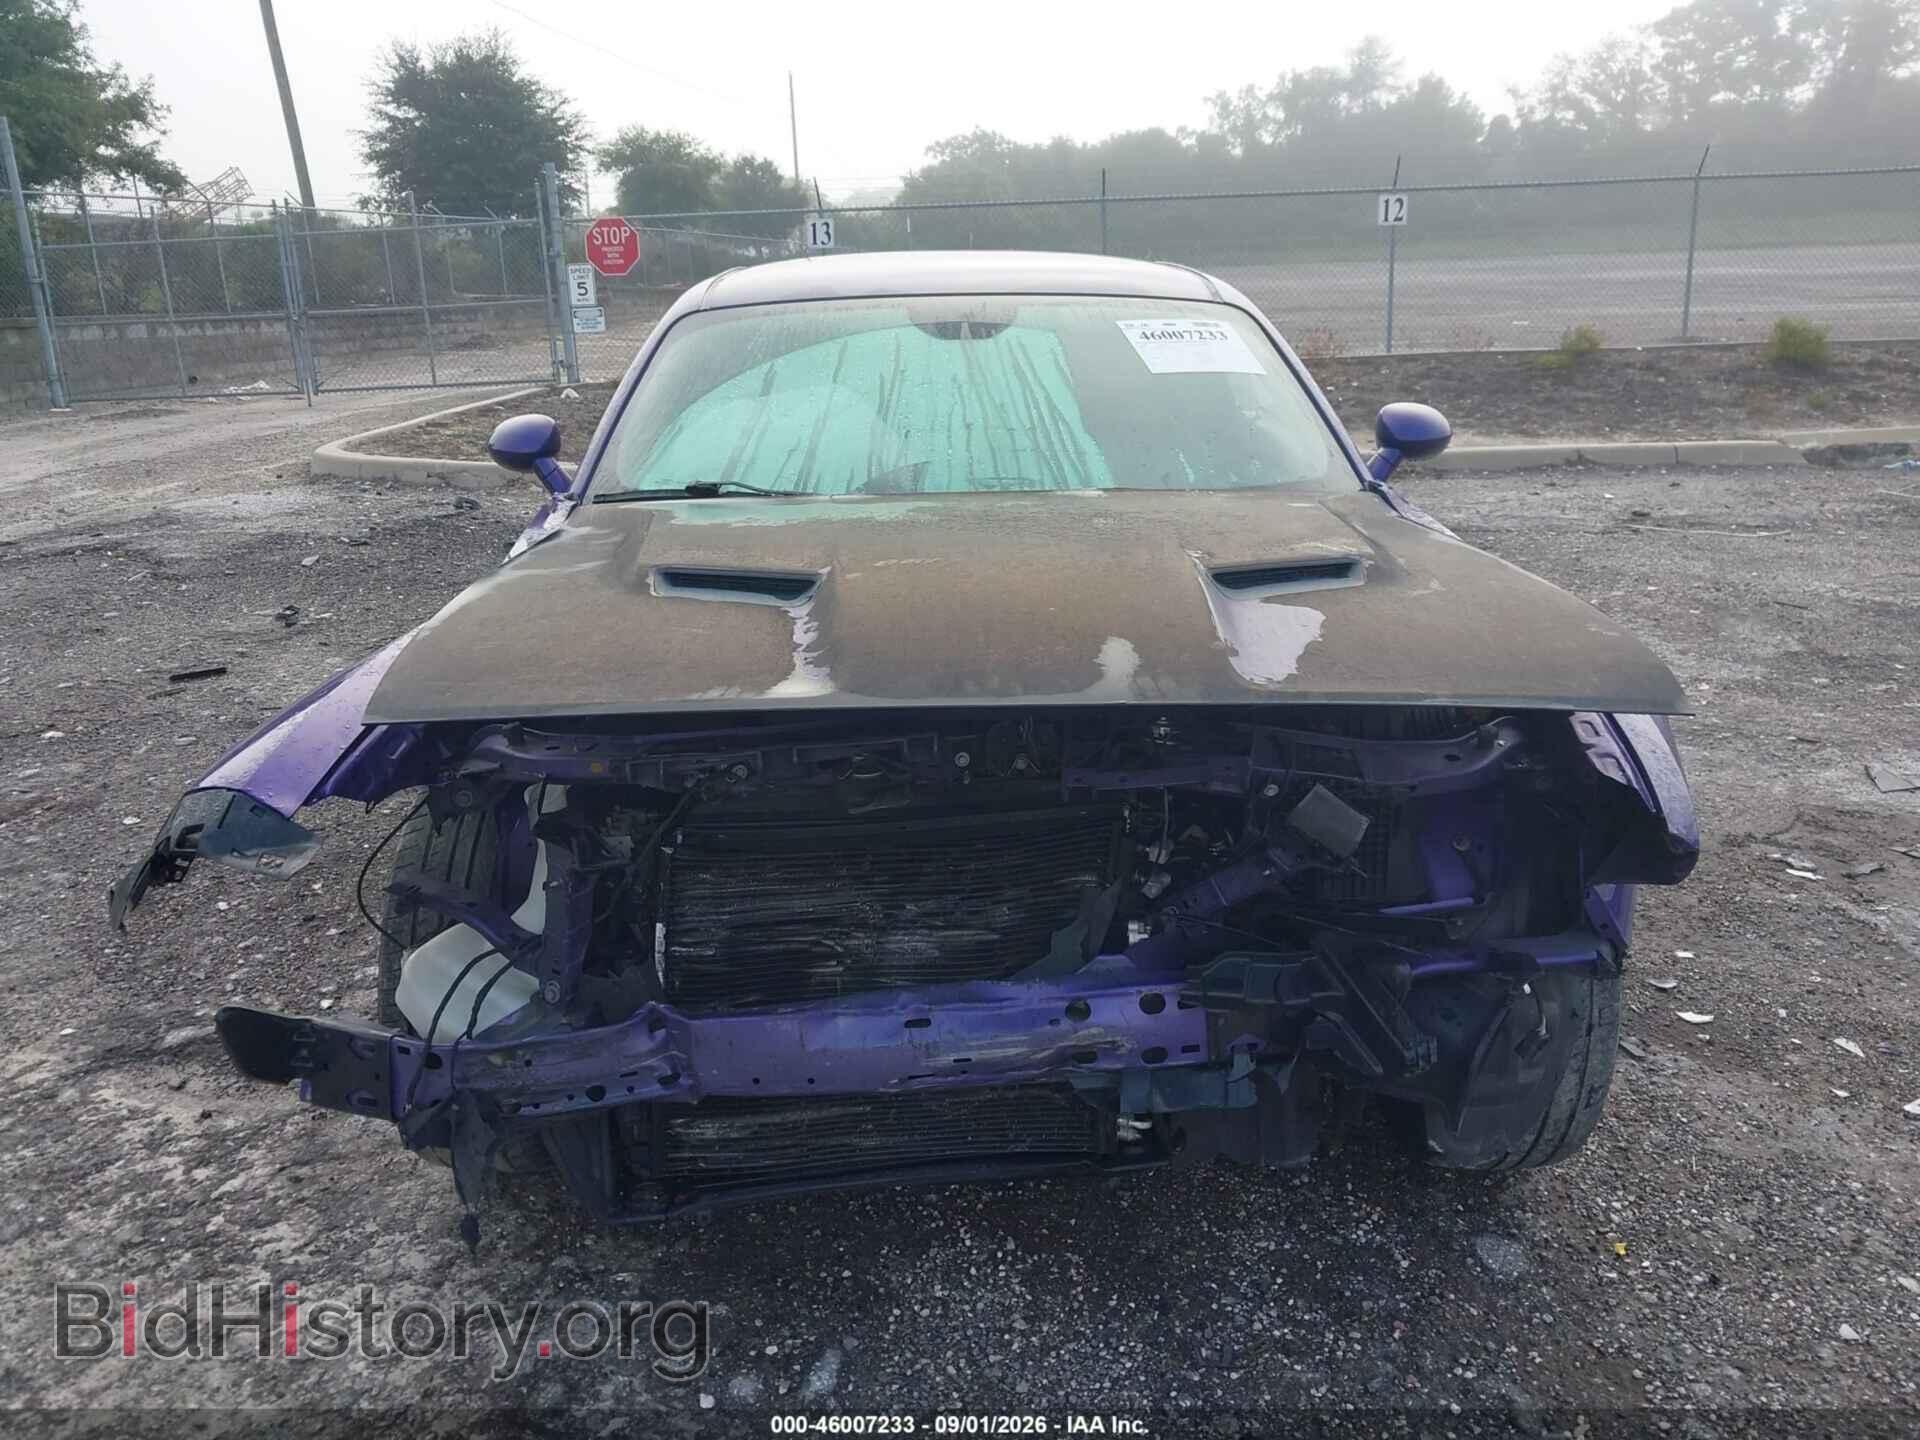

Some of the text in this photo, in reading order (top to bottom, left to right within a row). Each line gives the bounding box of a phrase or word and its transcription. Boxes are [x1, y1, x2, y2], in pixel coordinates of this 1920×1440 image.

[1384, 198, 1404, 222] 12
[592, 226, 630, 245] STOP
[811, 222, 832, 245] 13
[577, 282, 588, 296] 5
[1139, 329, 1228, 341] 46007233
